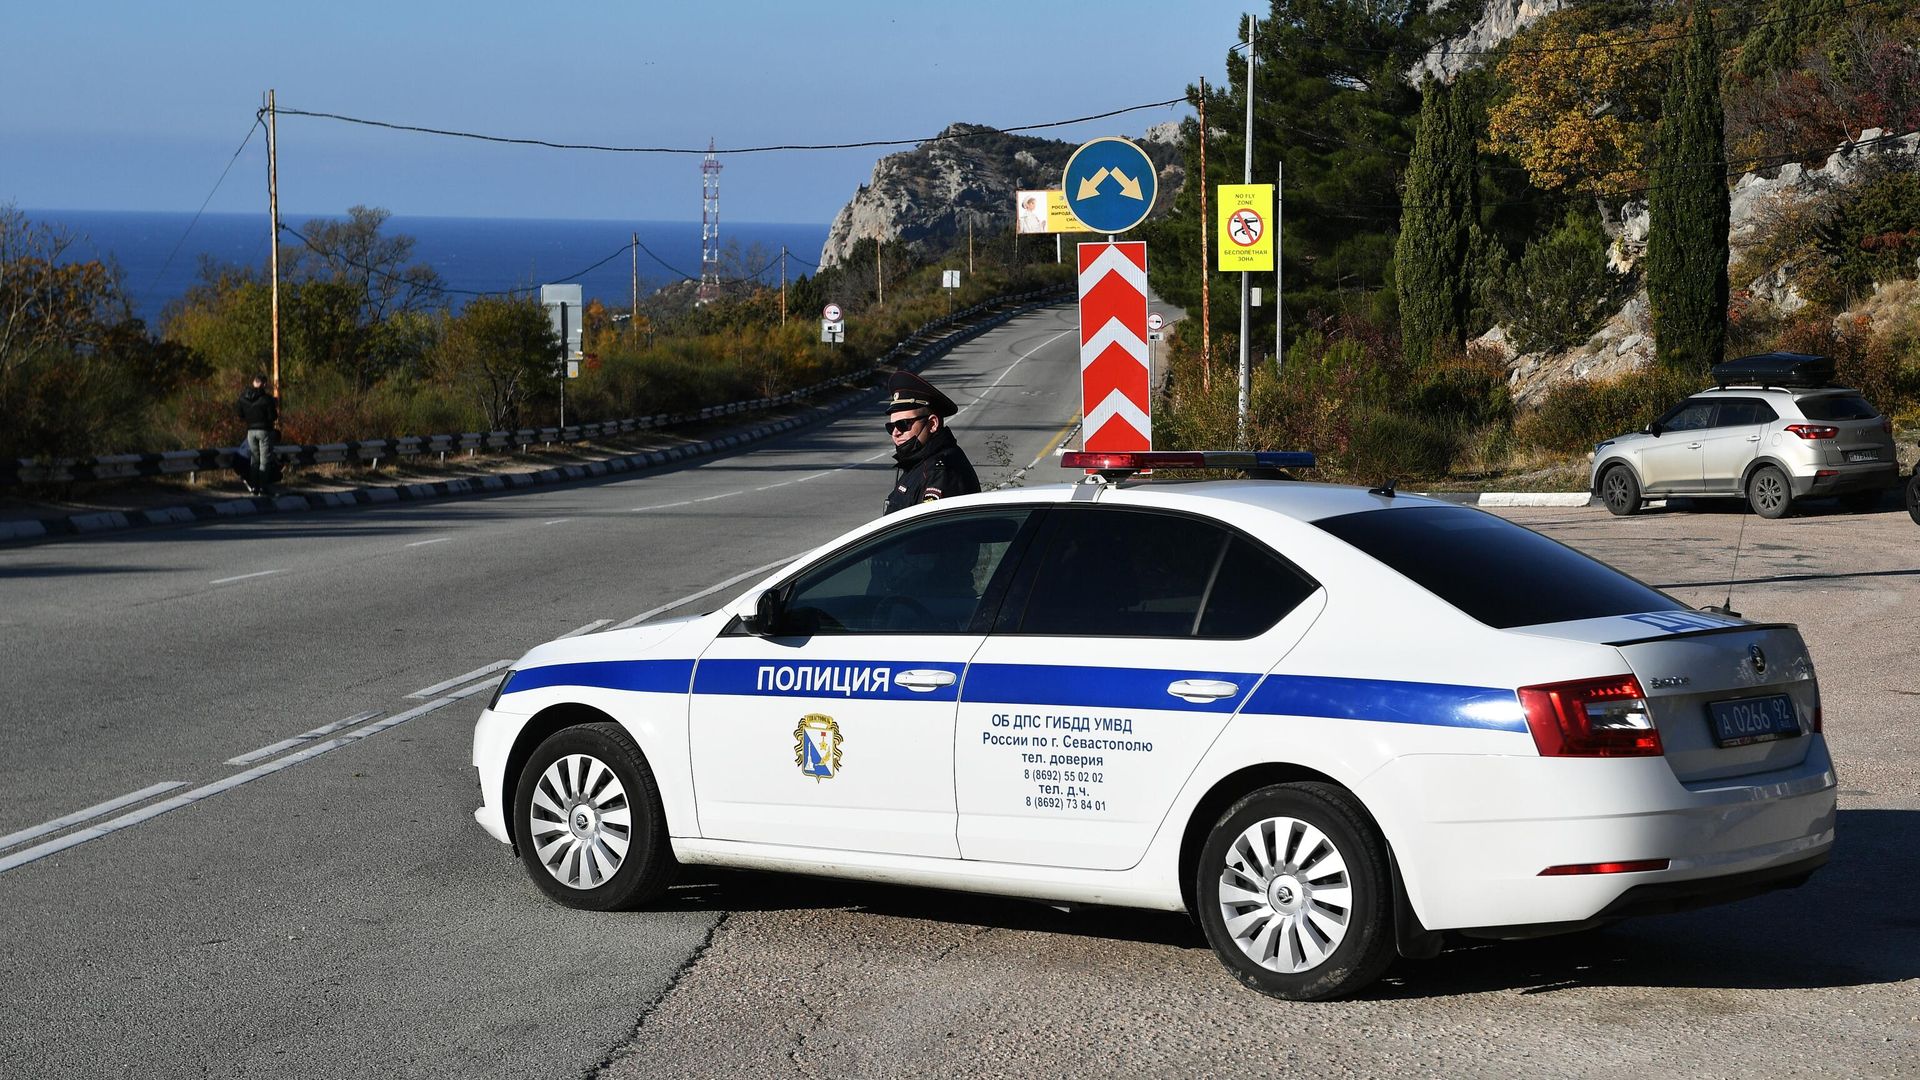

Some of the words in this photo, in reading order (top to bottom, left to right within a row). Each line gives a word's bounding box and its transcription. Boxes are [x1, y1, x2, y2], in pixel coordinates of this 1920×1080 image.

[757, 666, 891, 697] ПОЛИЦИЯ
[992, 713, 1010, 727] ОБ
[1013, 714, 1041, 730] ДПС
[1045, 716, 1090, 732] ГИБДД
[1094, 717, 1132, 734] УМВД
[1734, 702, 1770, 733] 0266
[1773, 699, 1789, 720] 92
[983, 731, 1028, 746] России
[1032, 736, 1048, 747] по
[1051, 737, 1059, 748] г.
[1062, 734, 1153, 752] Севастополю
[1021, 753, 1046, 764] тел.
[1049, 754, 1104, 769] доверия
[1024, 768, 1030, 780] 8
[1032, 769, 1062, 784] (8692)
[1064, 770, 1076, 782] 55
[1078, 771, 1090, 783] 02
[1092, 772, 1104, 784] 02
[1038, 784, 1064, 795] тел.
[1067, 786, 1090, 798] д.ч.
[1025, 796, 1032, 807] 8
[1034, 796, 1064, 811] (8692)
[1066, 798, 1078, 809] 73
[1080, 799, 1093, 810] 84
[1095, 800, 1106, 812] 01
